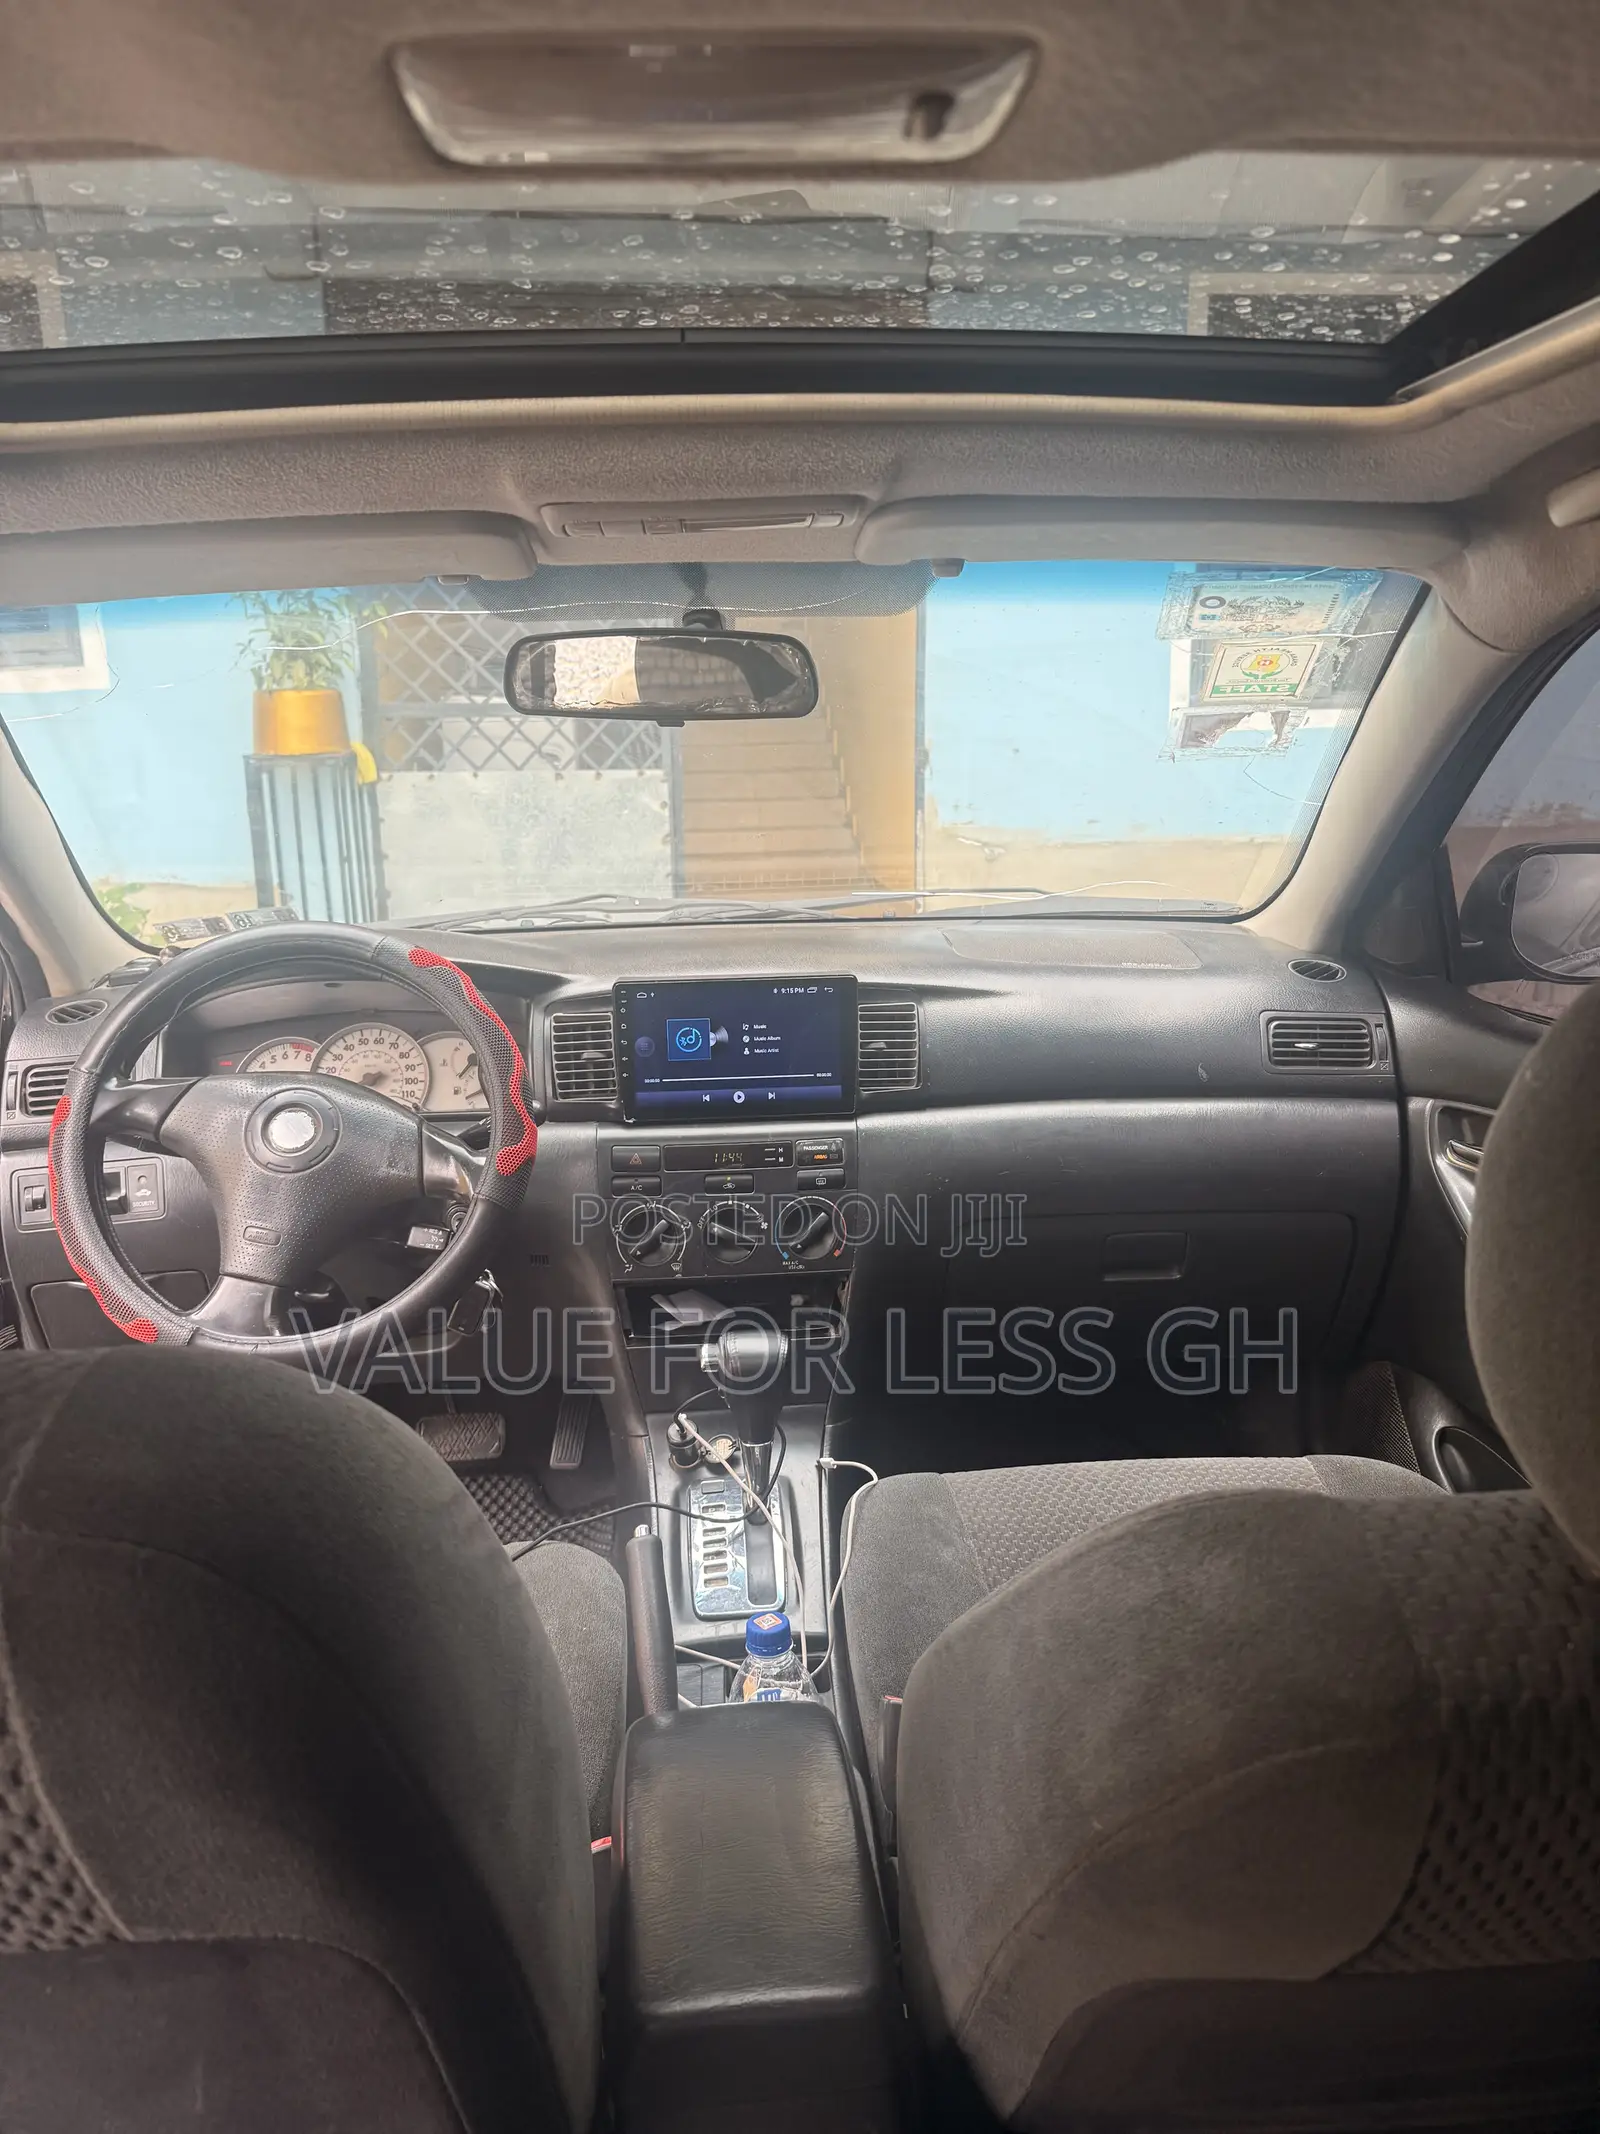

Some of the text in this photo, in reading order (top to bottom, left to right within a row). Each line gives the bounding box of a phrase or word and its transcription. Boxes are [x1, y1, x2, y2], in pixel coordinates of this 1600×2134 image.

[794, 987, 805, 995] PM
[358, 1038, 370, 1046] 50
[373, 1037, 385, 1045] 60
[343, 1044, 355, 1052] 40
[388, 1042, 399, 1050] 70
[270, 1054, 277, 1064] 5
[282, 1050, 289, 1060] 6
[294, 1050, 302, 1060] 7
[305, 1053, 312, 1062] 8
[332, 1054, 343, 1062] 30
[398, 1051, 410, 1060] 80
[258, 1060, 266, 1070] 4
[404, 1064, 416, 1072] 90
[325, 1066, 337, 1074] 20
[404, 1077, 419, 1086] 100
[402, 1090, 415, 1099] 110
[714, 1152, 743, 1163] 11:44
